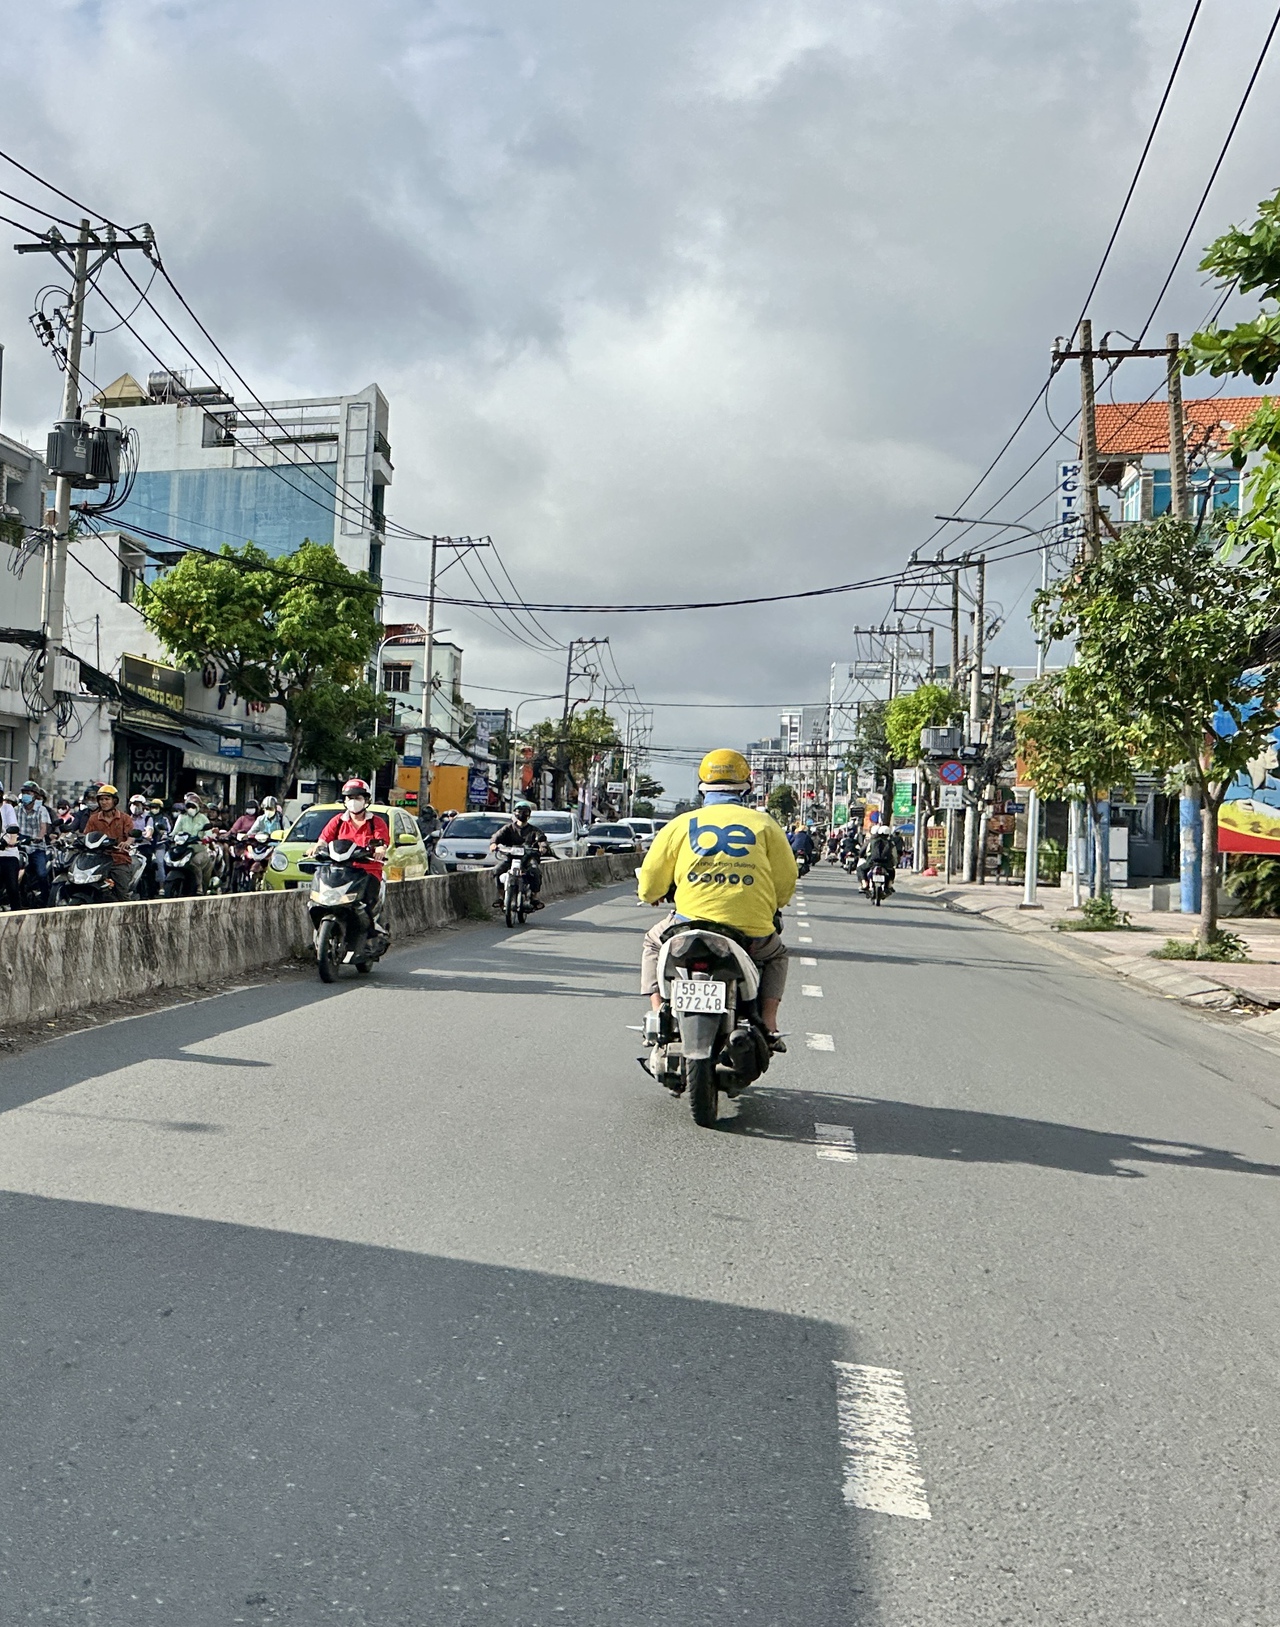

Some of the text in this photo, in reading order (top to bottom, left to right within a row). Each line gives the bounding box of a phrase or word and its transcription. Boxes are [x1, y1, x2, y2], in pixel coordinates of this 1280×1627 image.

[132, 772, 164, 783] NAM
[688, 817, 757, 857] be
[681, 982, 718, 997] 59-C2
[676, 996, 722, 1011] 372.48
